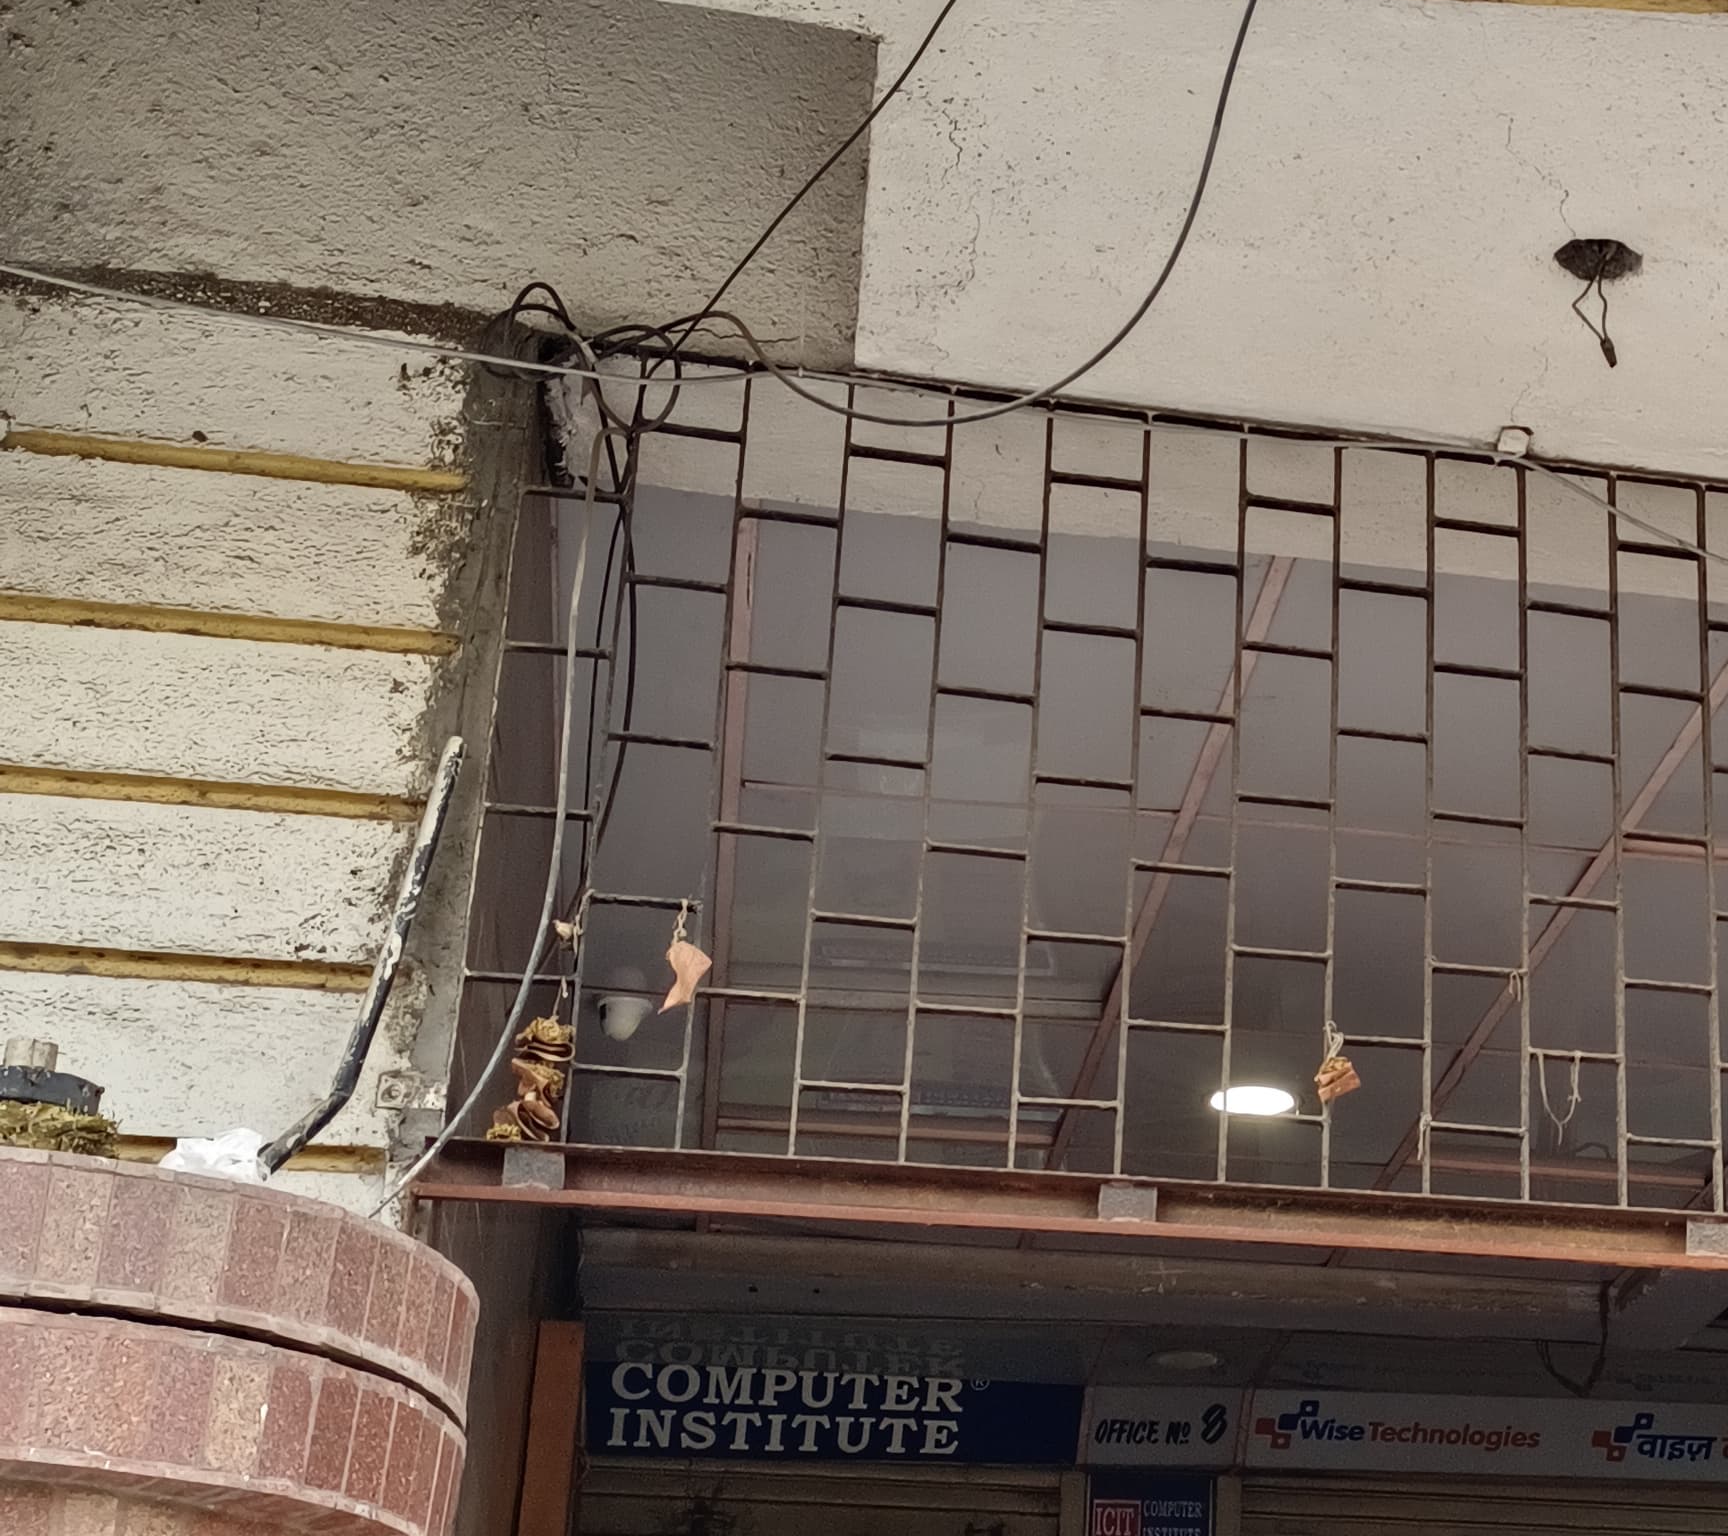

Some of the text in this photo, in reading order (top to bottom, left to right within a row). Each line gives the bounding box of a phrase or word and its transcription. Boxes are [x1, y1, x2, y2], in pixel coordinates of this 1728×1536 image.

[605, 1406, 961, 1456] INSTITUTE
[1094, 1419, 1160, 1446] OFFICE
[1200, 1403, 1228, 1446] 8
[1299, 1418, 1541, 1451] Wise Technologies
